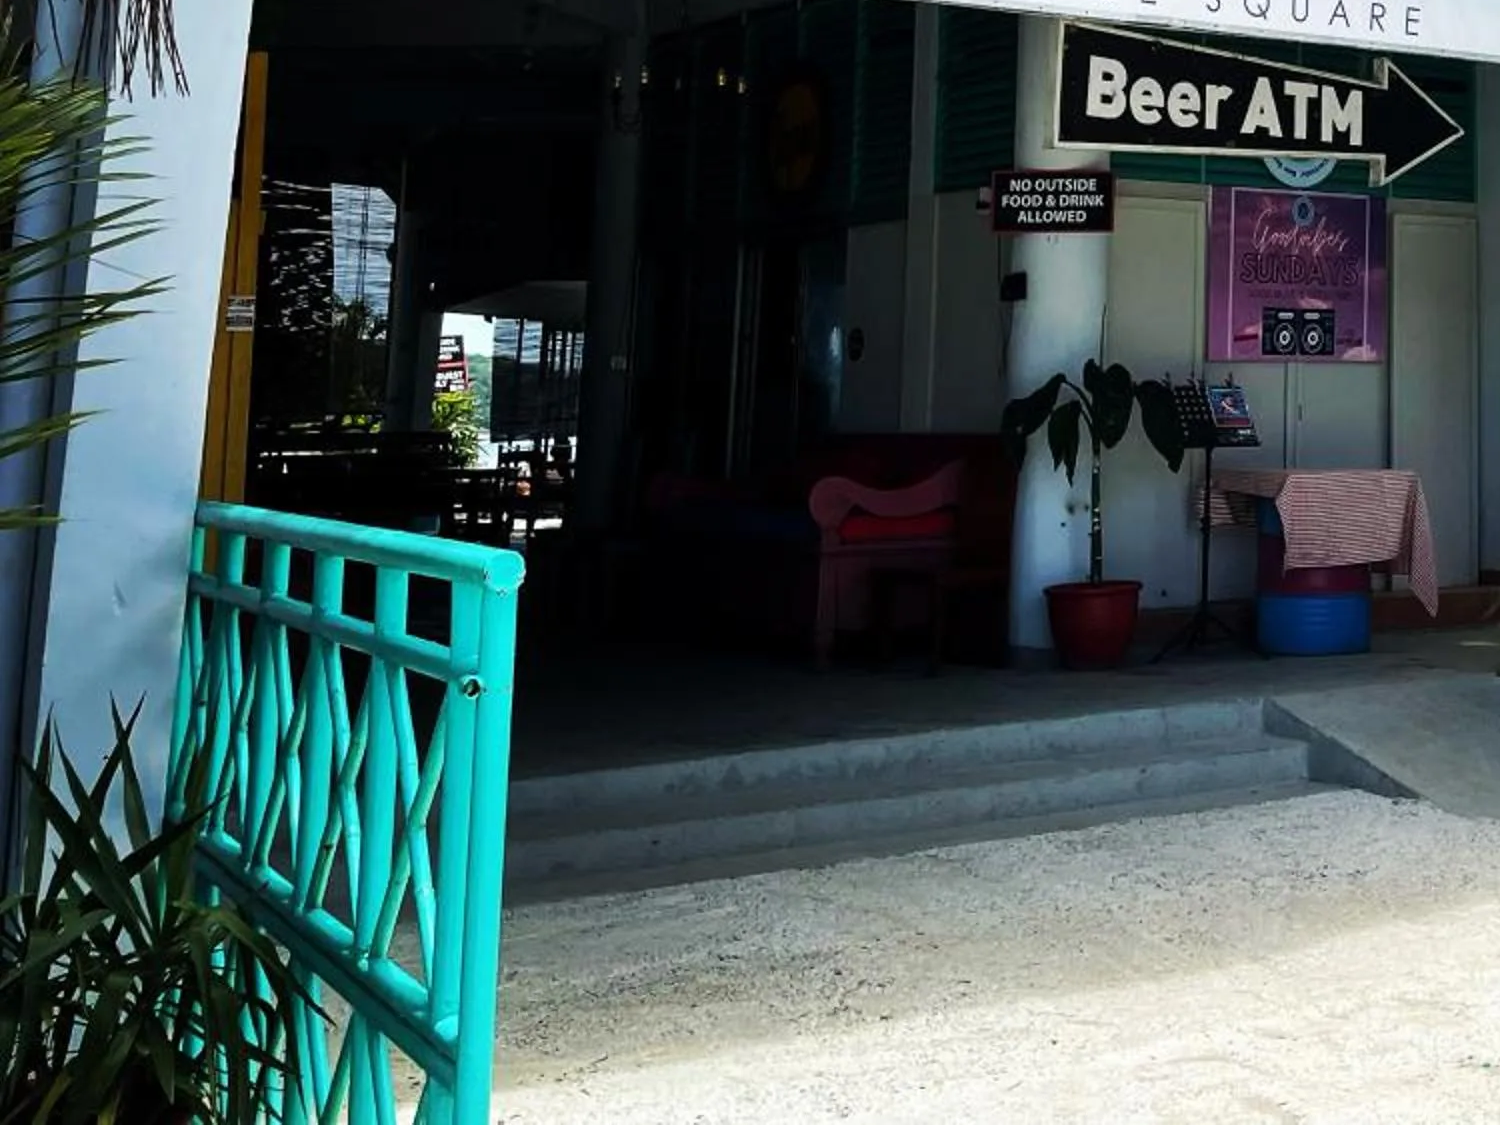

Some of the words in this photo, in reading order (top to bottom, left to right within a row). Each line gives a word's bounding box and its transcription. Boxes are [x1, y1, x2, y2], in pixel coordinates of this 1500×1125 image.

[1085, 54, 1233, 130] Beer
[1240, 76, 1363, 147] ATM
[1009, 178, 1032, 192] NO
[1034, 178, 1097, 192] OUTSIDE
[1001, 194, 1043, 208] FOOD
[1045, 194, 1057, 208] &
[1059, 194, 1105, 208] DRINK
[1017, 210, 1087, 224] ALLOWED
[1239, 252, 1359, 288] SUNDAYS
